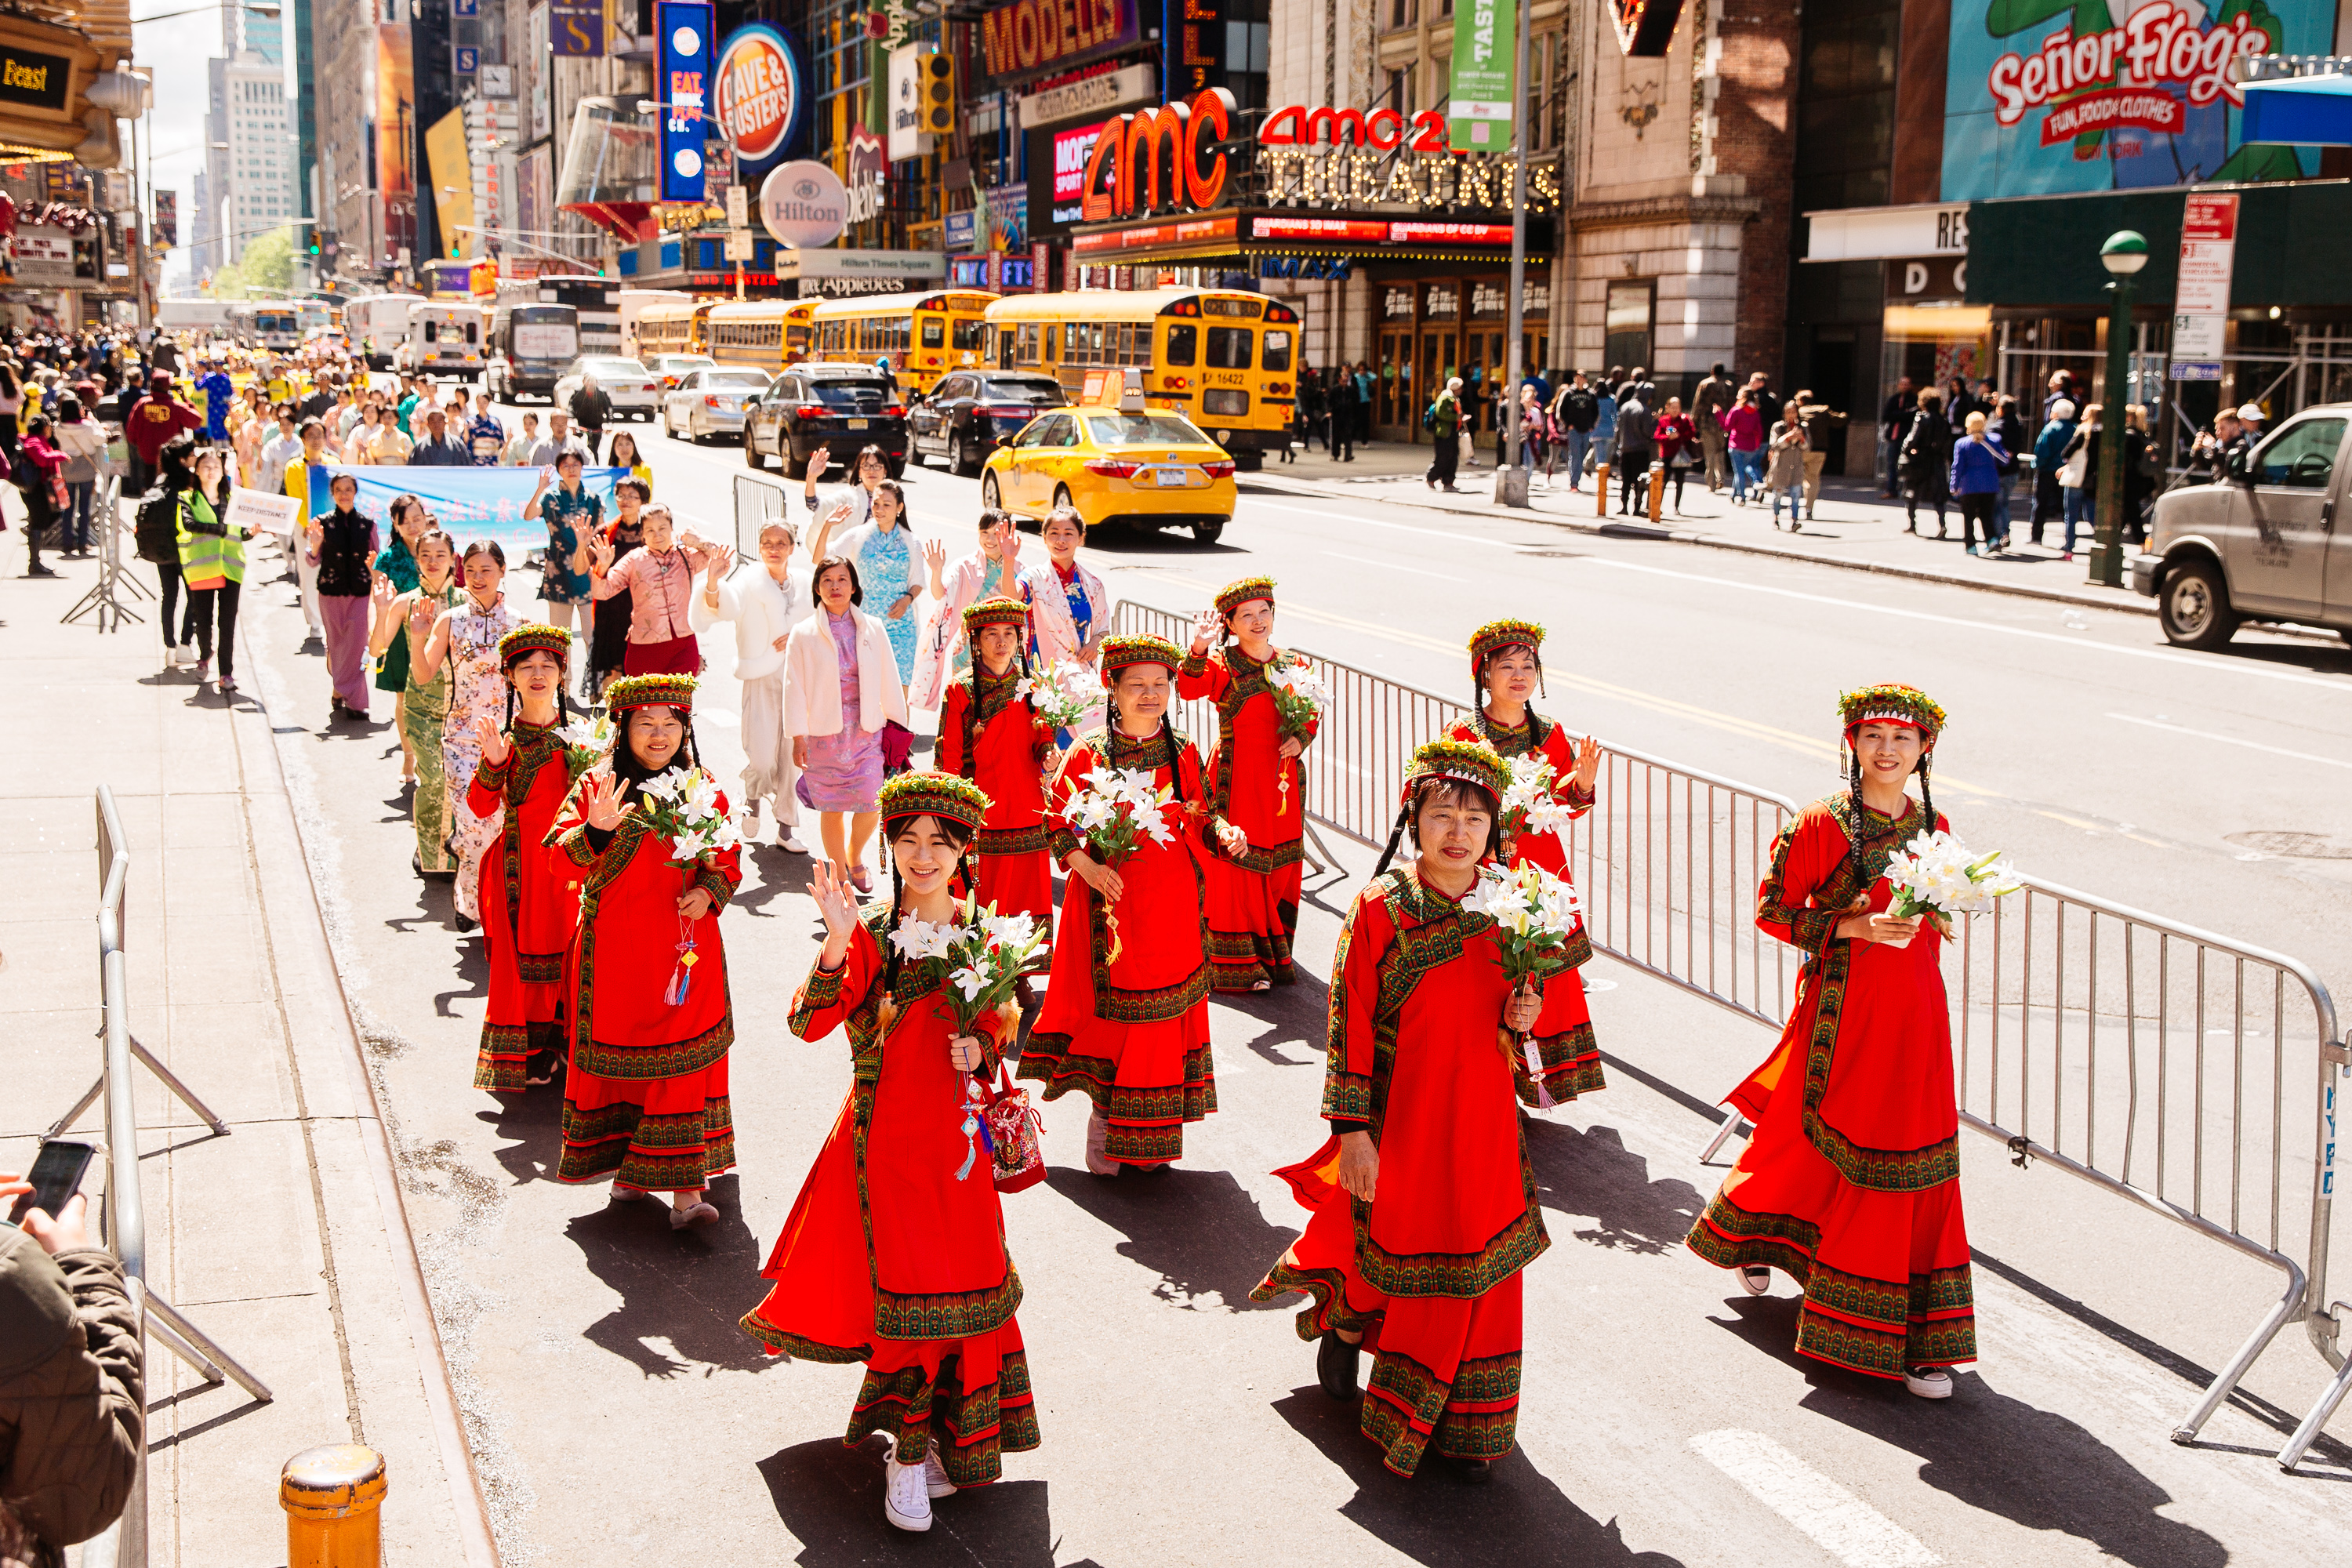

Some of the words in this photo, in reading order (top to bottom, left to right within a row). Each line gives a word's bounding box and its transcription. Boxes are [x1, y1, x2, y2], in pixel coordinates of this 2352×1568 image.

[880, 0, 908, 52] Appl
[1991, 27, 2126, 124] Señor
[2125, 3, 2268, 105] Frog's
[671, 71, 704, 94] EAT.
[722, 56, 771, 111] DAVE
[766, 53, 786, 87] &
[724, 85, 789, 139] BUSTER'S
[2078, 97, 2114, 125] FOOD
[2119, 95, 2176, 124] CLOTHES
[775, 201, 840, 223] Hilton
[840, 258, 869, 268] Hilton
[871, 259, 898, 268] Times
[900, 260, 931, 271] Square
[1260, 257, 1349, 280] IMAX
[1217, 373, 1244, 385] 16422
[256, 508, 287, 519] DISTANCE
[492, 529, 507, 543] is
